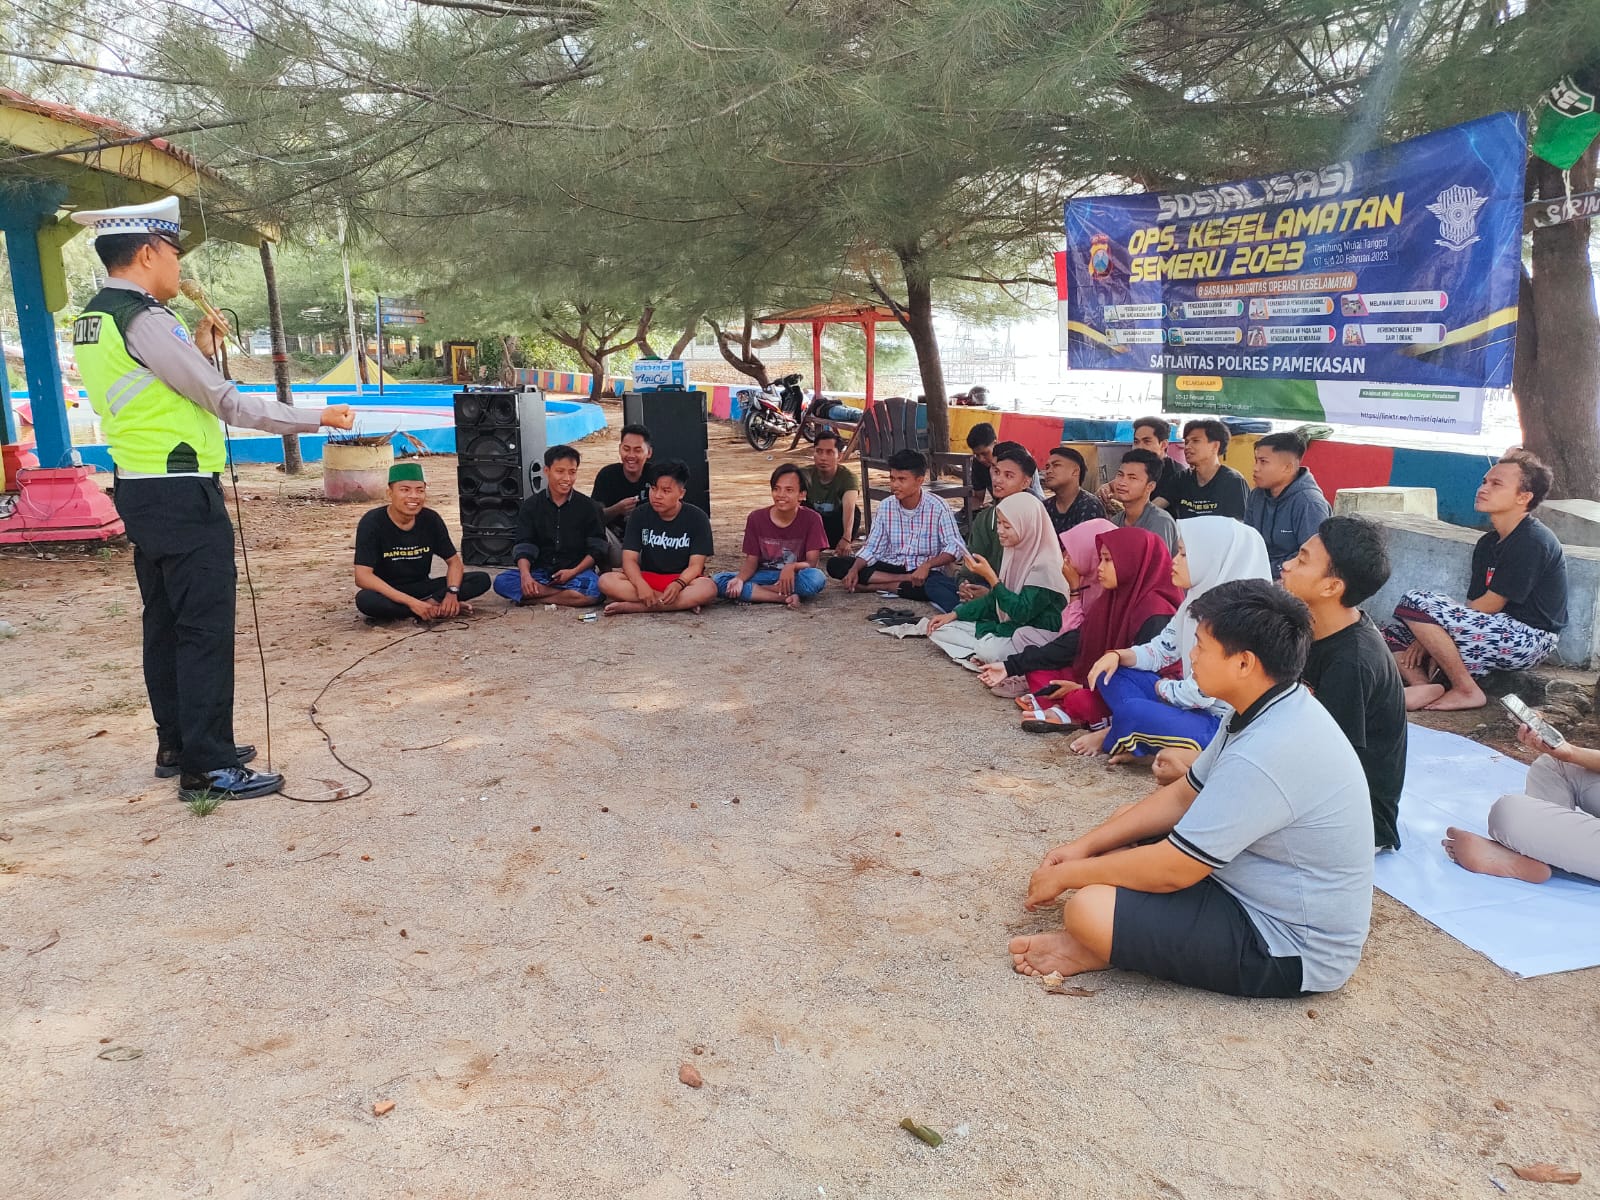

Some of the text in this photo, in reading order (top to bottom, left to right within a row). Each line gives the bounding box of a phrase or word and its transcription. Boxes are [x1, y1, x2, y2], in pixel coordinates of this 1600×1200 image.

[1157, 160, 1355, 221] SOSIALISASI
[1127, 191, 1405, 256] OPS. KESELAMATAN
[1344, 239, 1363, 251] Mulai
[1364, 236, 1389, 250] Tanggal
[1129, 241, 1307, 283] SEMERU 2023
[1371, 250, 1389, 262] 2023
[1204, 283, 1234, 296] SASARAN
[1235, 280, 1268, 295] PRIORITAS
[1268, 278, 1299, 293] OPERASI
[1300, 274, 1353, 292] KESELAMATAN
[75, 319, 101, 342] OLISI
[1150, 354, 1366, 374] SATLANTAS POLRES PAMEKASAN
[648, 529, 690, 550] kakanda
[383, 546, 430, 558] PANGESTU
